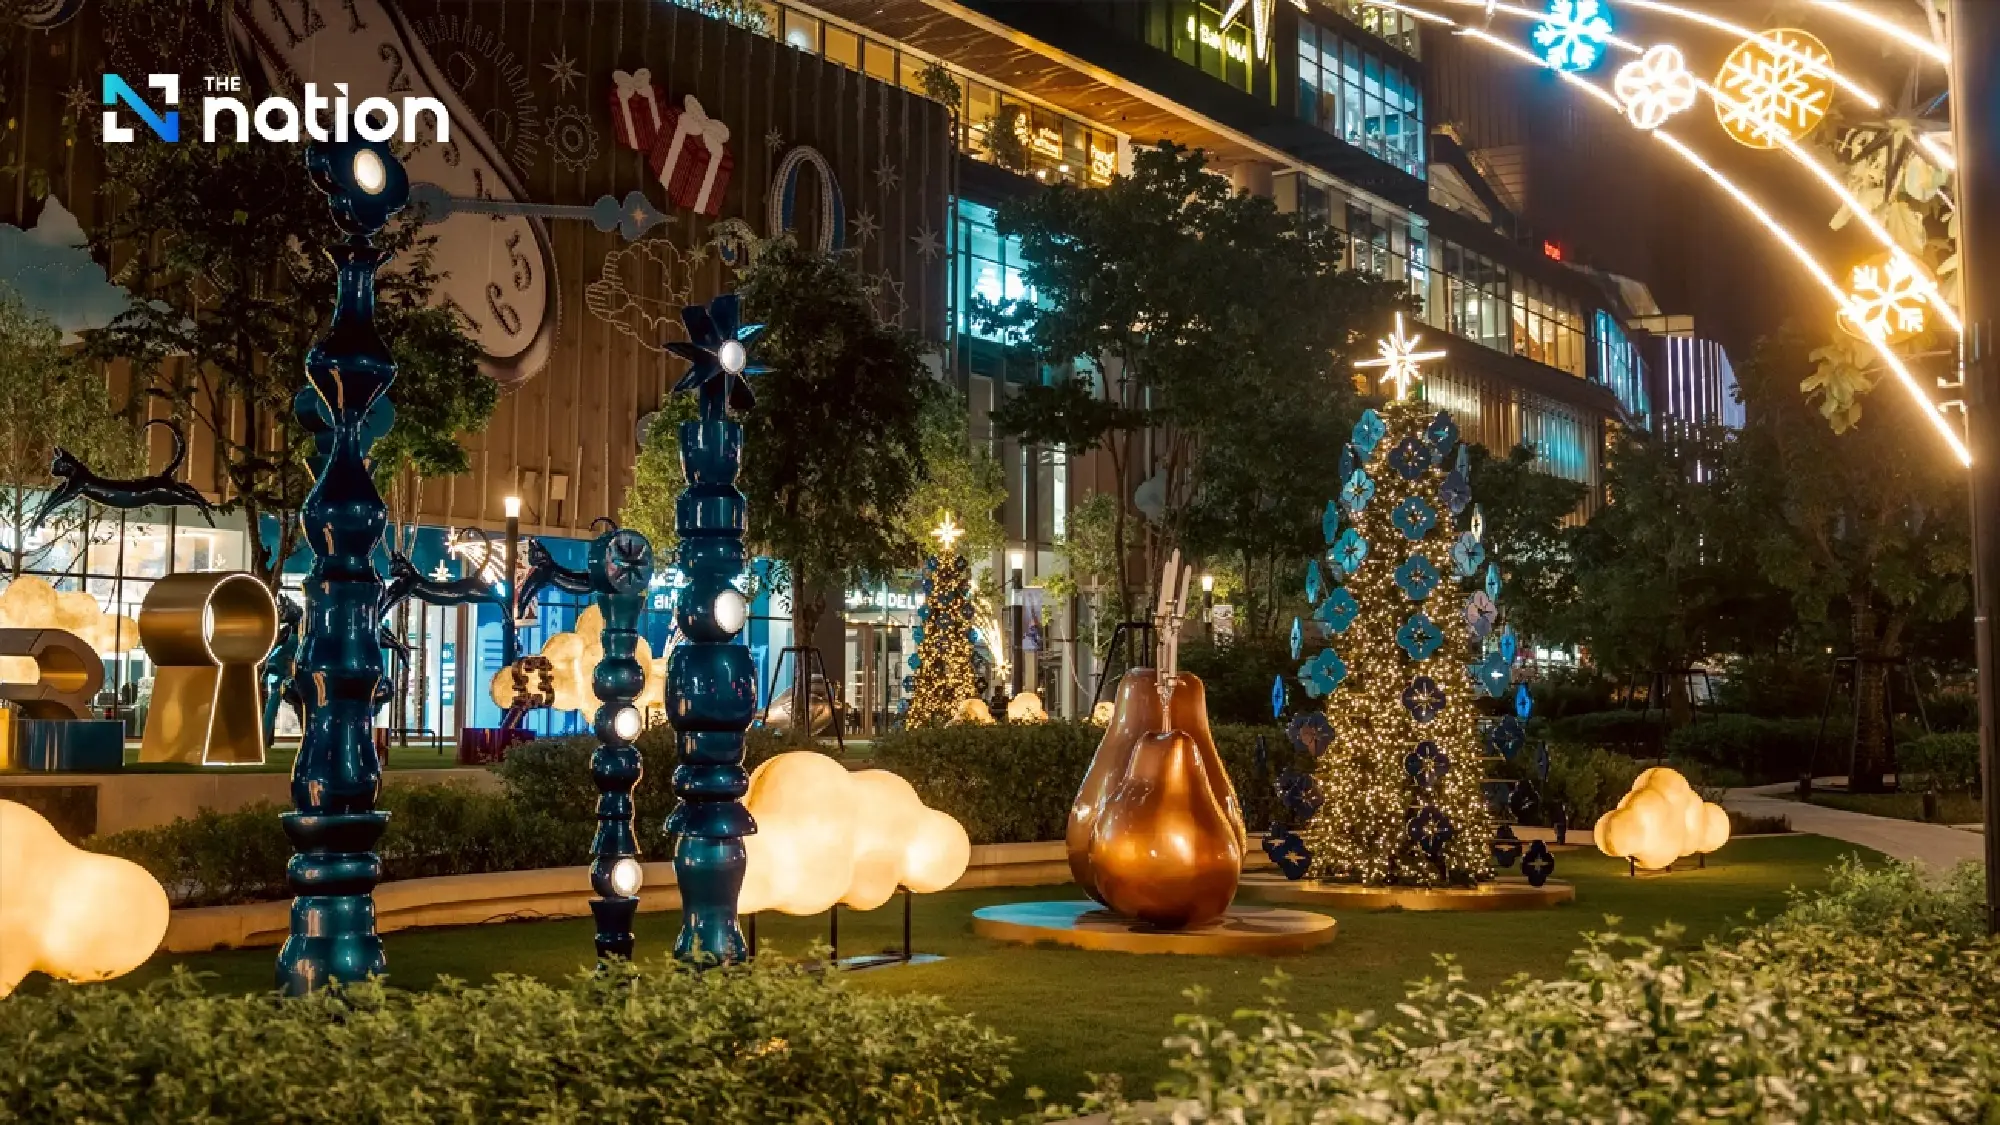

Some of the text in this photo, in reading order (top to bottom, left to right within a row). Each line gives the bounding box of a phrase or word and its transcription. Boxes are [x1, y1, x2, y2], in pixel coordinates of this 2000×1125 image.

[377, 43, 416, 93] 2
[504, 228, 533, 292] 5
[485, 281, 523, 338] 6
